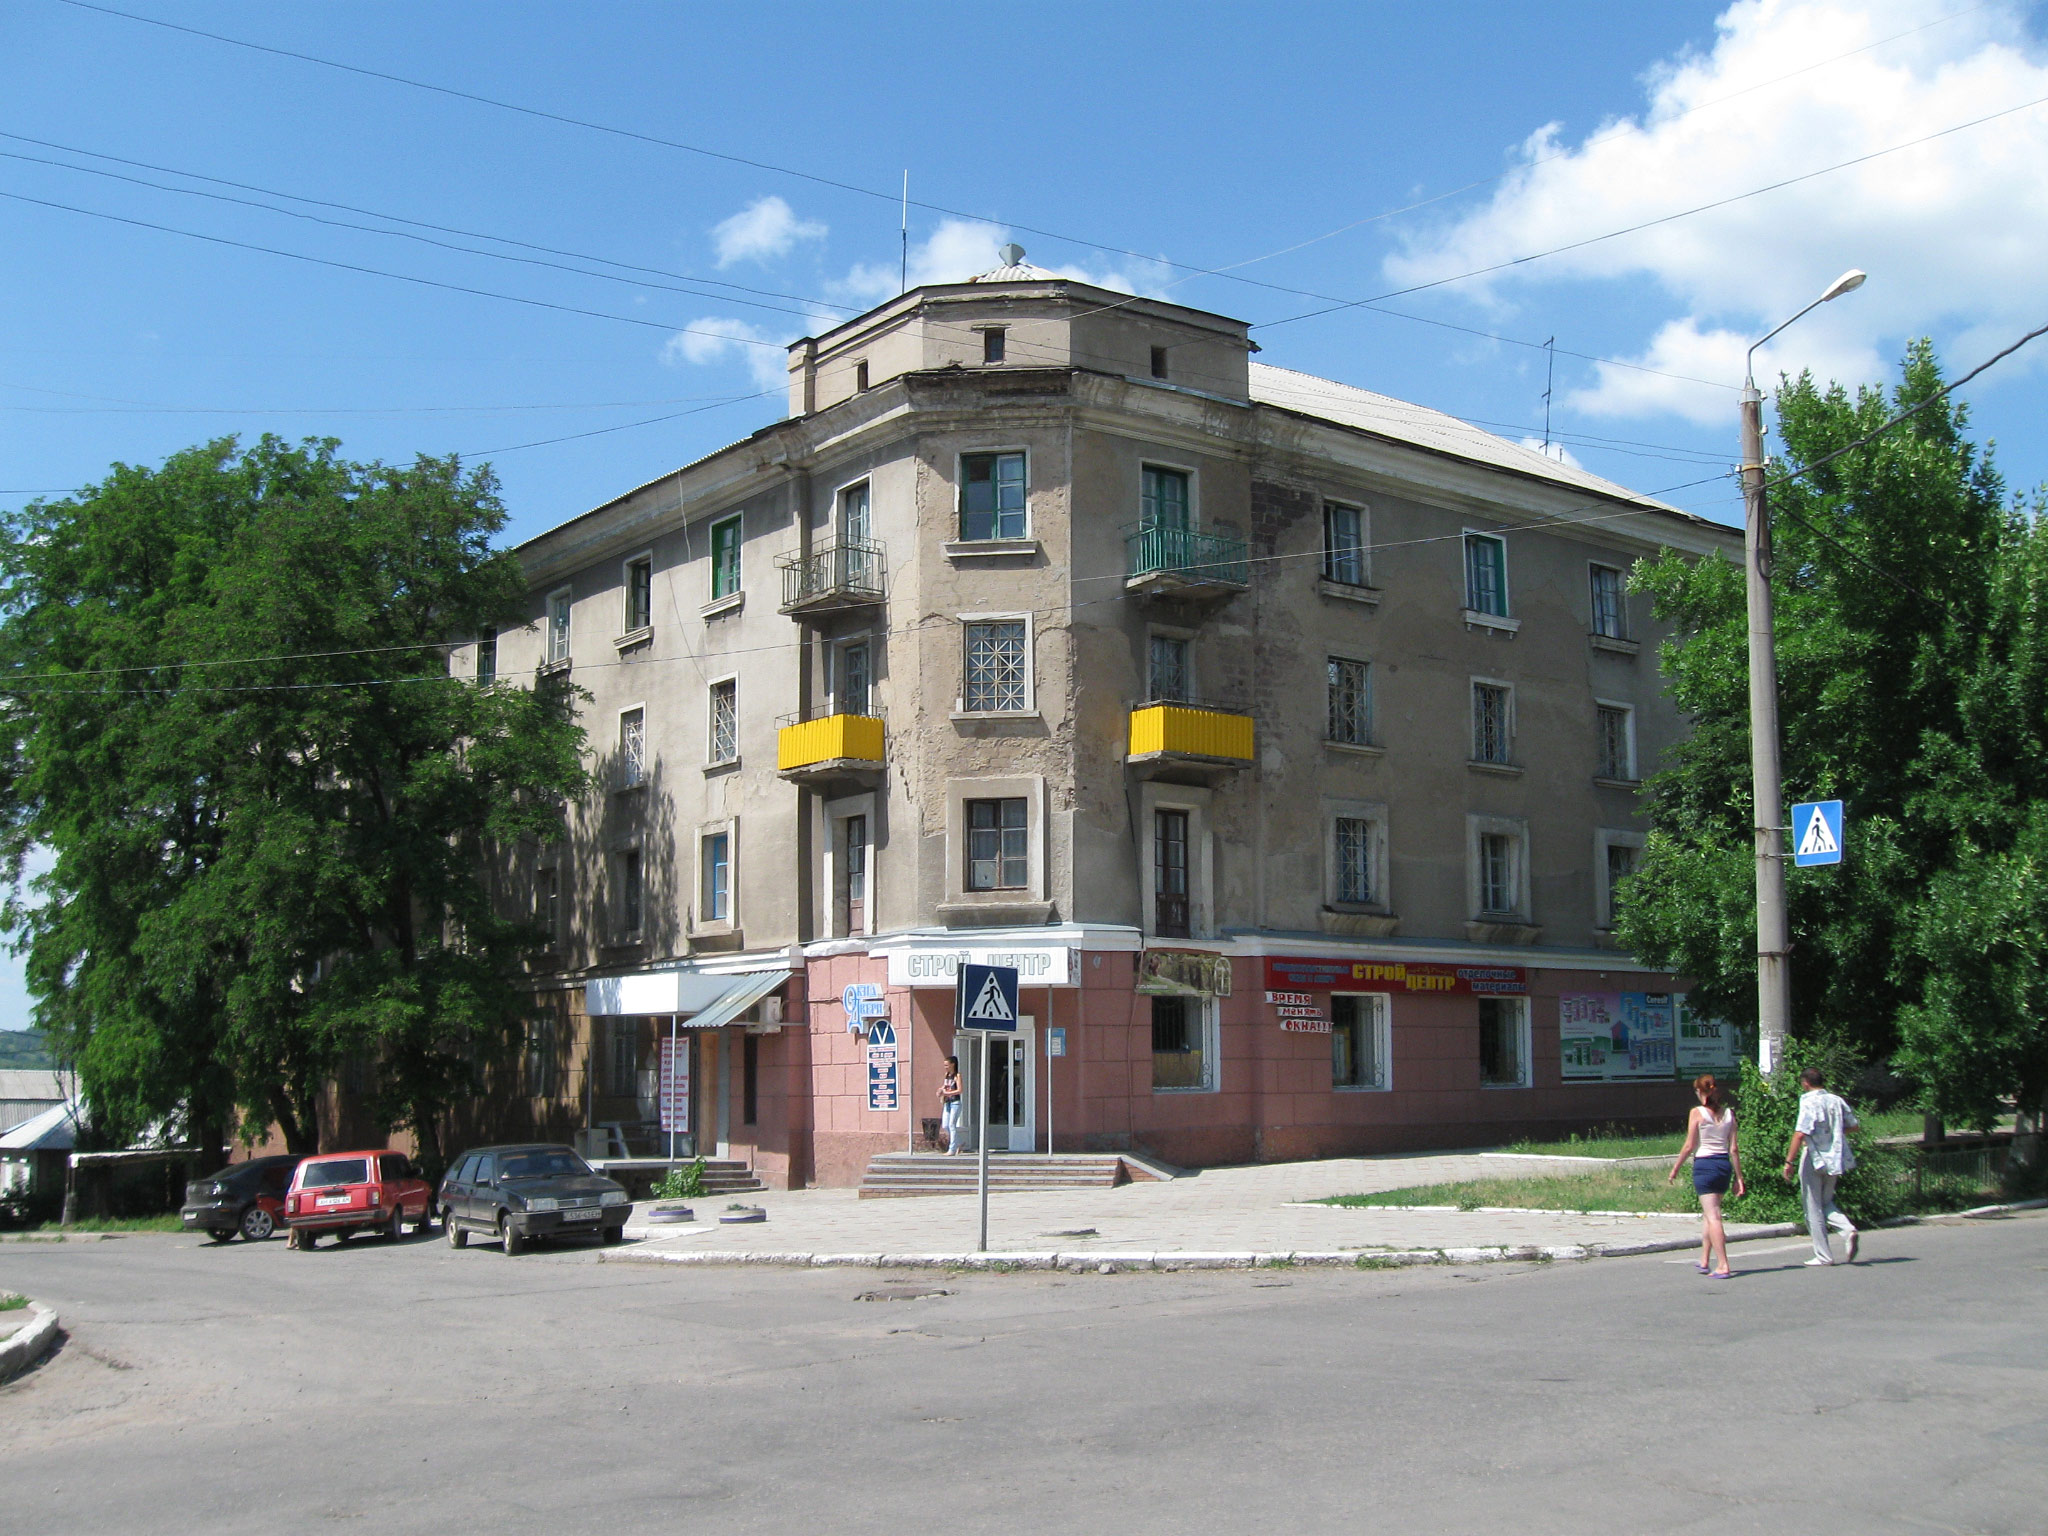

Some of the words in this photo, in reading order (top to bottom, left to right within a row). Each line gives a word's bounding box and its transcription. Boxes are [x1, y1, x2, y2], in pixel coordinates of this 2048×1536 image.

[1352, 964, 1407, 981] СТРОЙ
[1406, 974, 1456, 991] ЦЕНТР
[1457, 968, 1517, 981] отделочные
[1471, 981, 1527, 994] материалы
[1271, 992, 1312, 1005] ВРЕМЯ
[1285, 1020, 1333, 1032] ОКНА!!!
